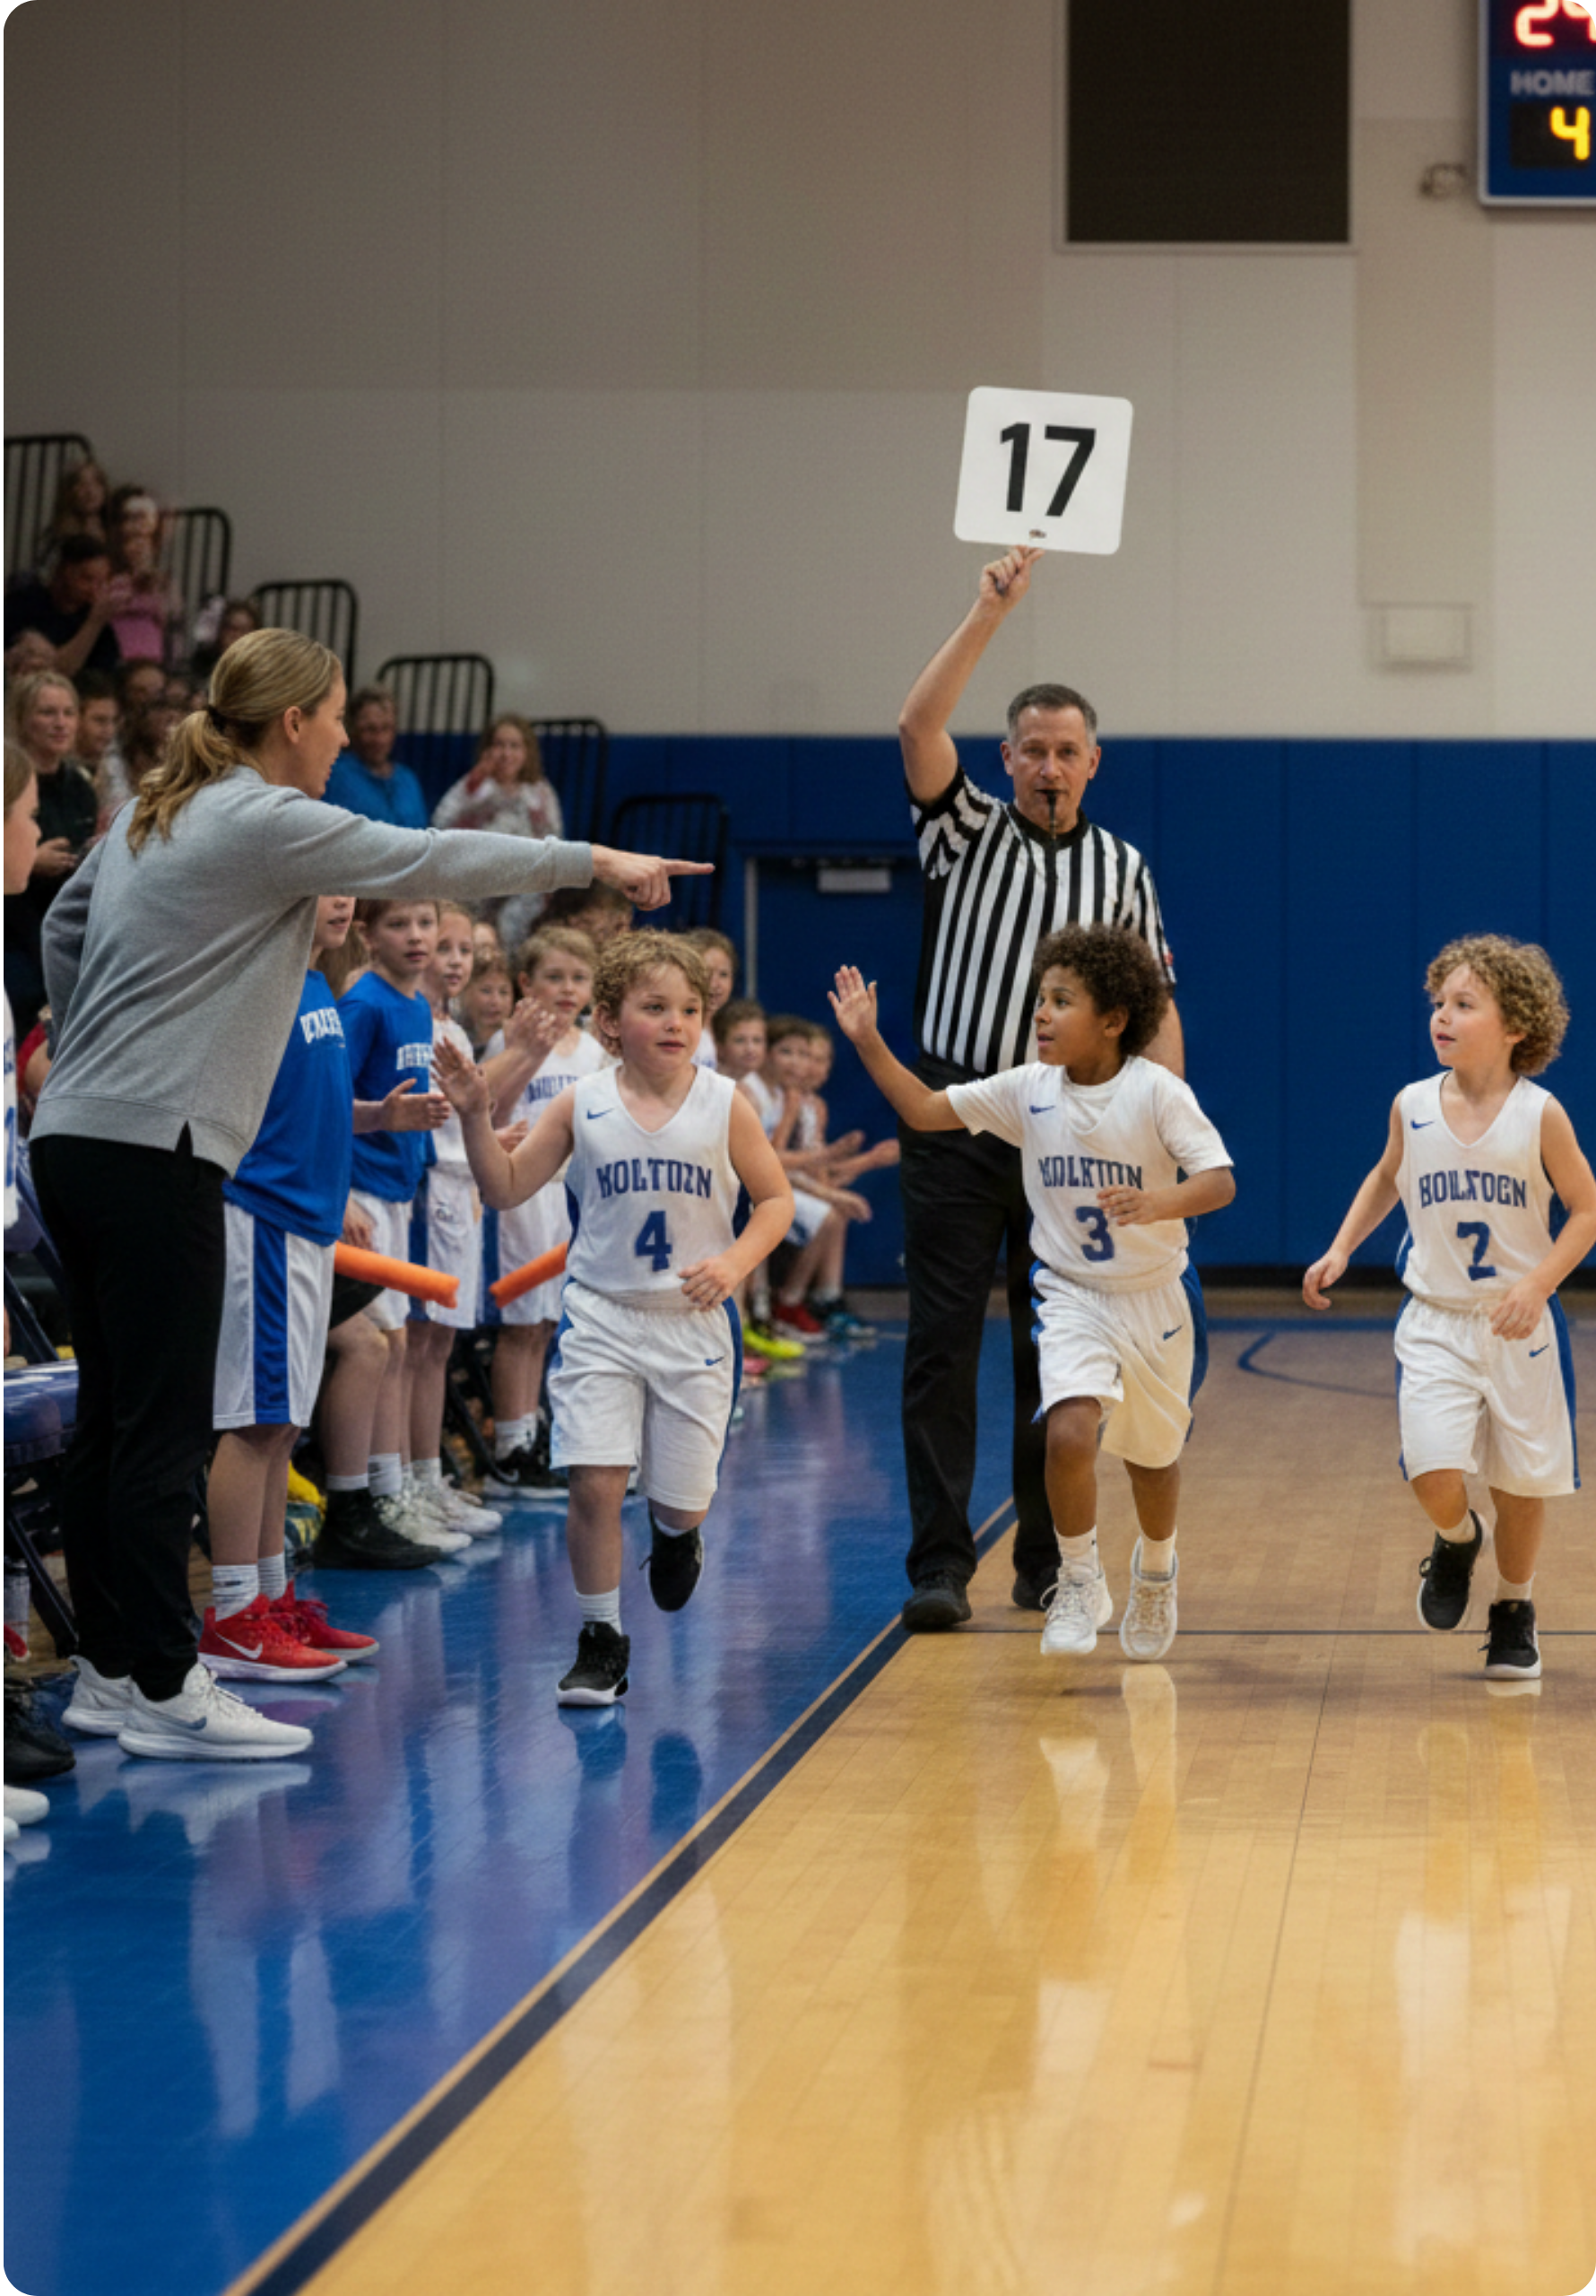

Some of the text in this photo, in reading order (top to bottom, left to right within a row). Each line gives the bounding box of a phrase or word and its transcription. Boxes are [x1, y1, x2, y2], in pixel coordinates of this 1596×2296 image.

[1510, 70, 1594, 96] HOME
[1550, 106, 1590, 160] 4
[1000, 422, 1097, 517] 17
[635, 1210, 672, 1272] 4
[1075, 1205, 1115, 1263] 3
[1456, 1222, 1496, 1281] 2
